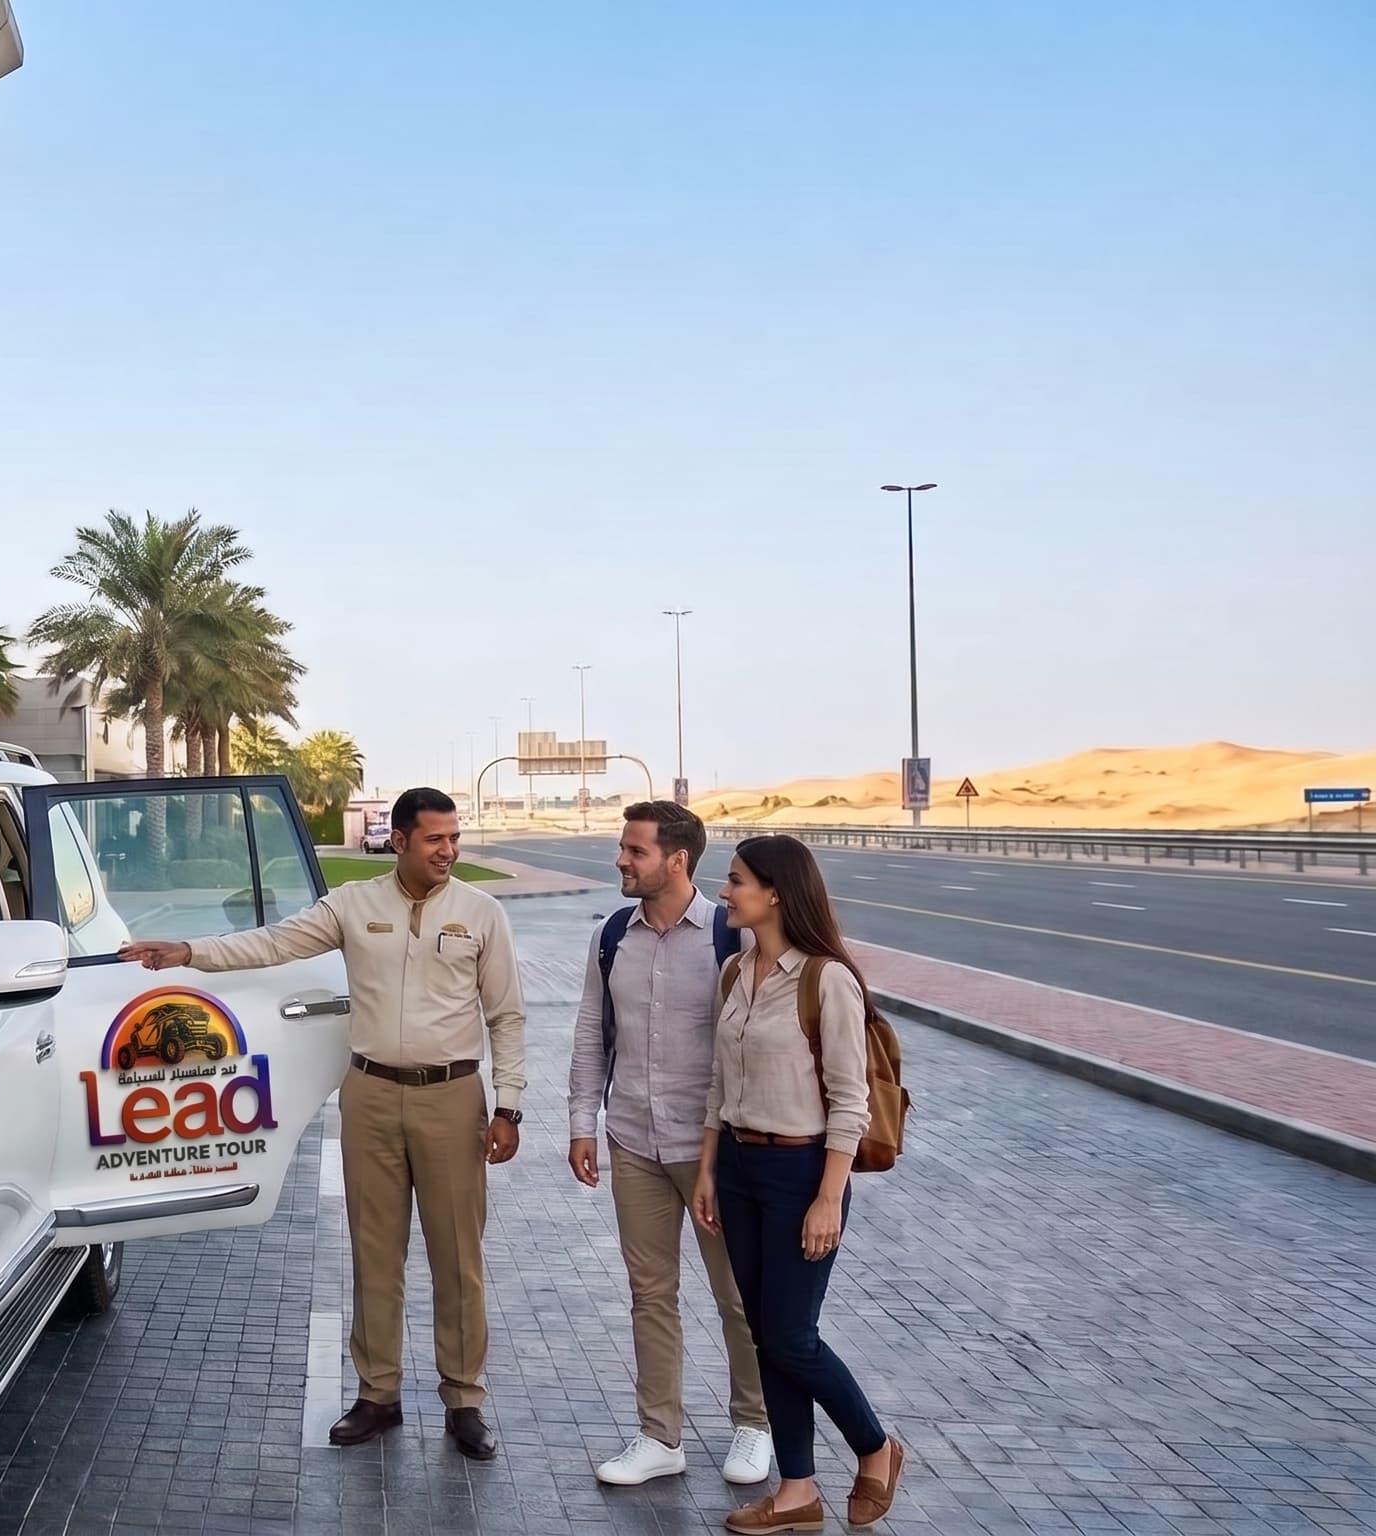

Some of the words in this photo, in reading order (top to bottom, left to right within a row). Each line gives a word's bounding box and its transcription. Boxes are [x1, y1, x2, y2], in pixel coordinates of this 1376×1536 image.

[79, 1054, 278, 1146] Lead
[96, 1144, 210, 1170] ADVENTURE
[215, 1139, 267, 1157] TOUR
